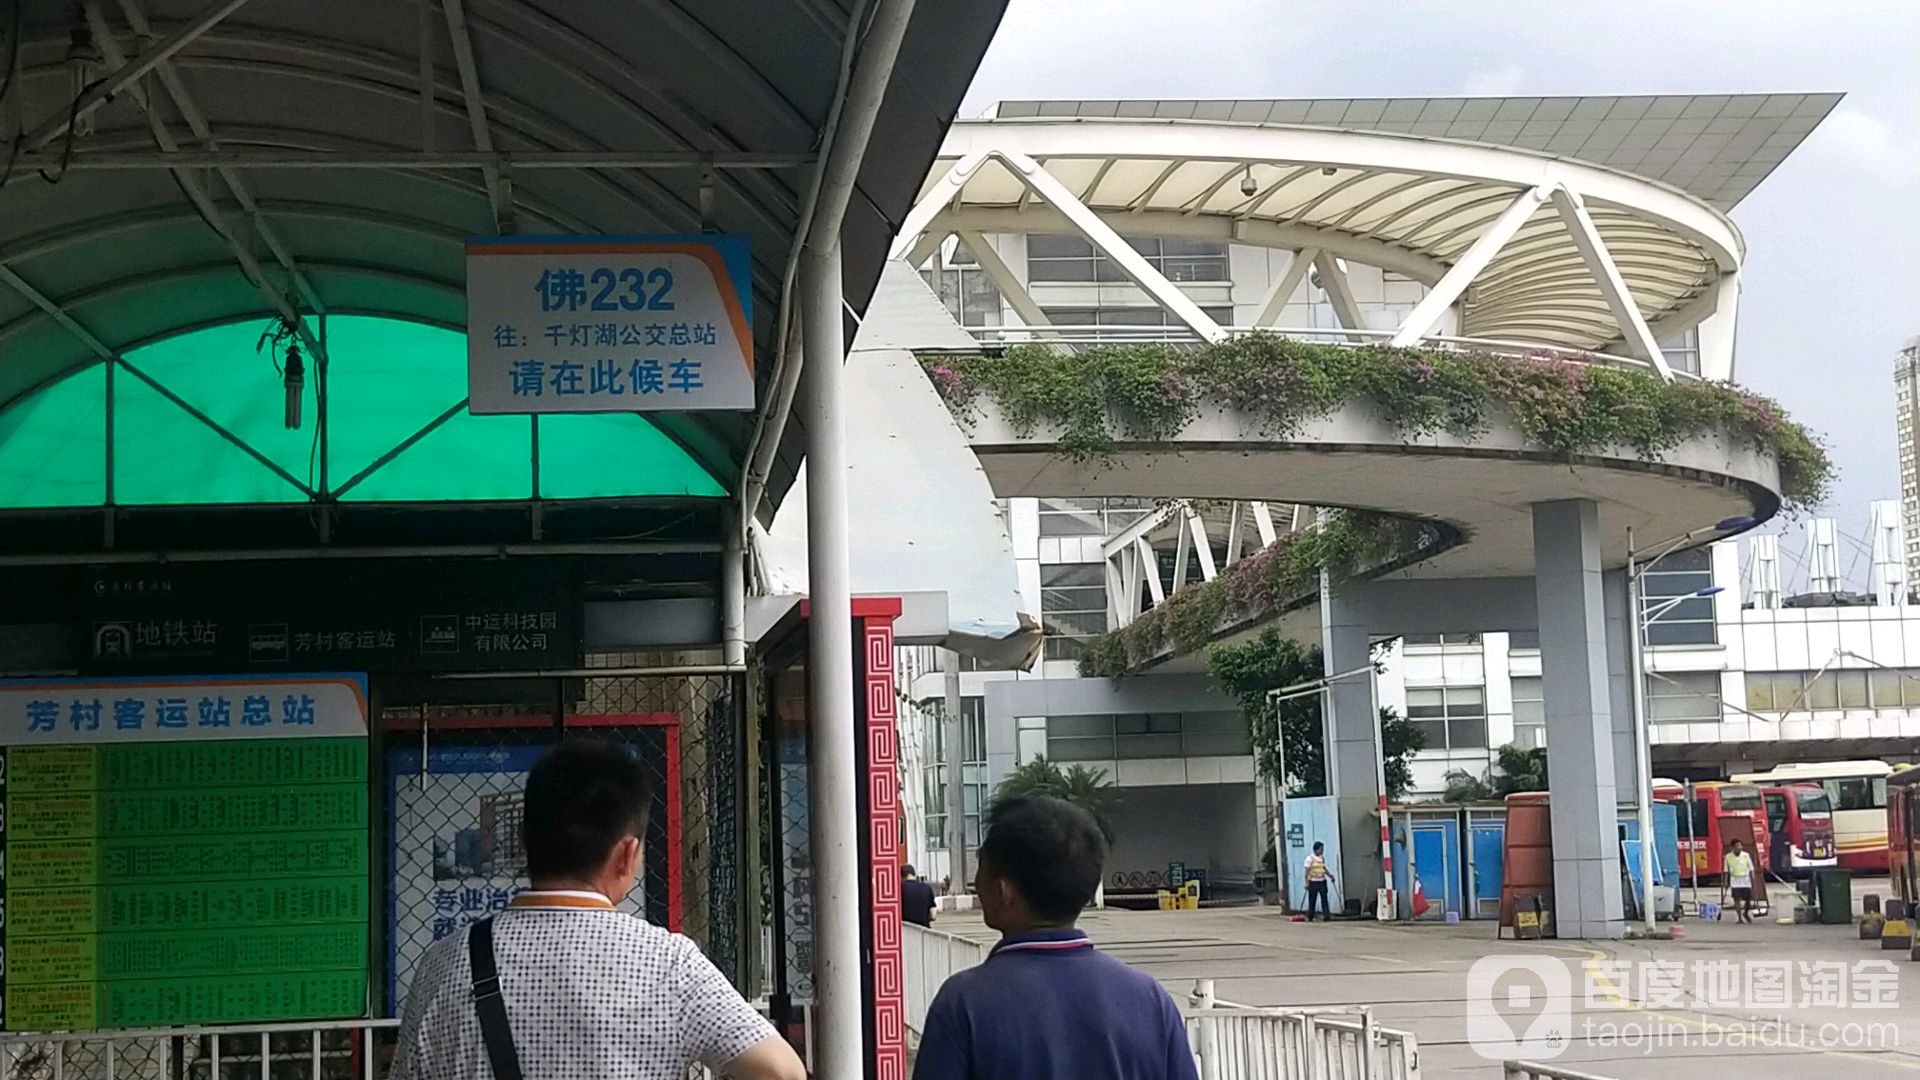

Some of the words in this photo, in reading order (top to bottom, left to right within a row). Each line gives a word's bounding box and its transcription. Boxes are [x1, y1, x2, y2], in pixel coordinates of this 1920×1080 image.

[534, 267, 675, 312] 佛232
[508, 357, 704, 397] 请在此候车
[135, 619, 218, 646] 地铁站
[465, 612, 557, 632] 中运科技园
[293, 631, 397, 652] 芳村客运站
[474, 634, 548, 652] 有限公司
[26, 693, 316, 733] 芳村客运站总站
